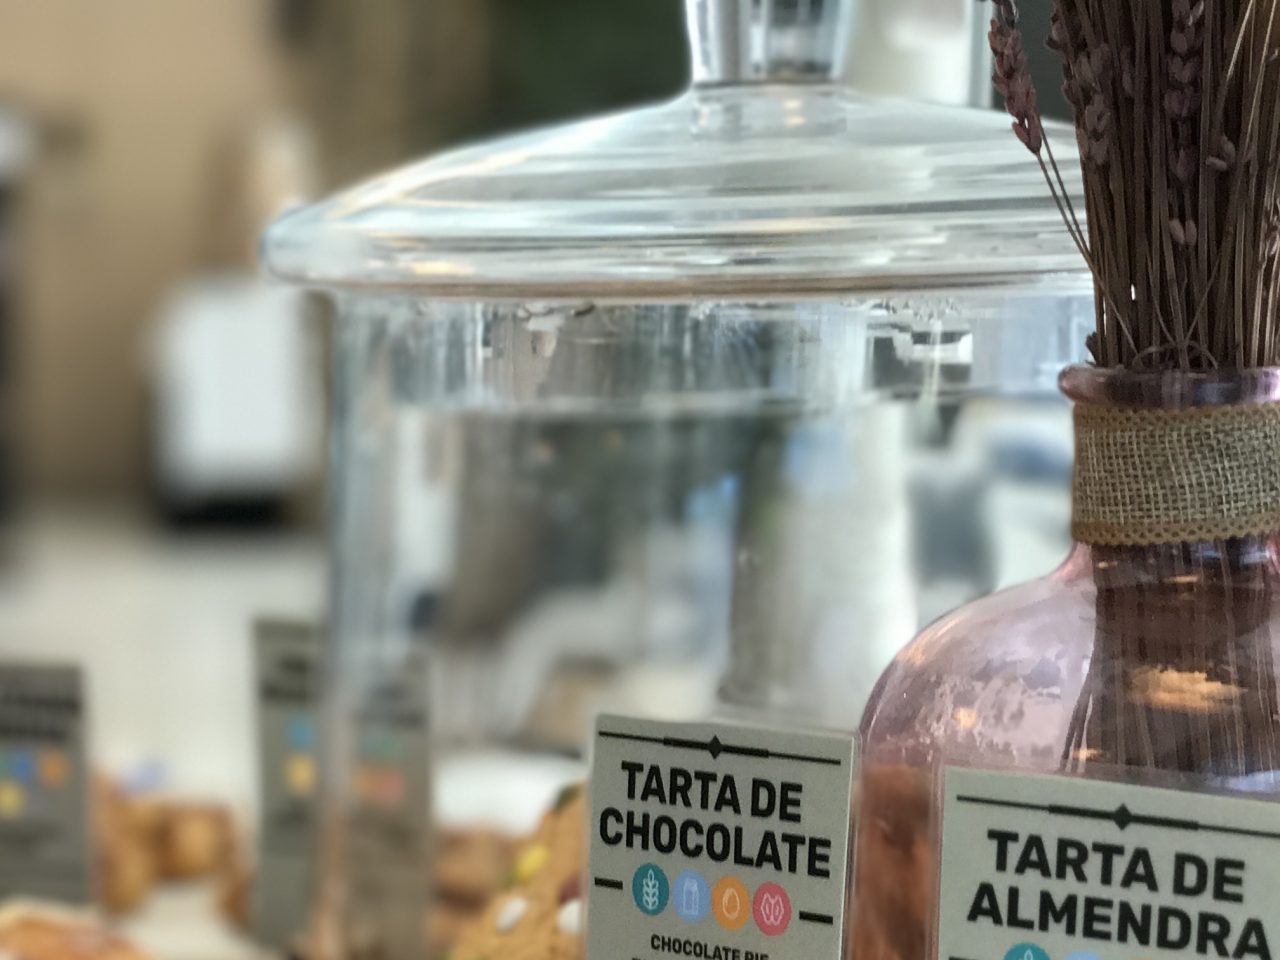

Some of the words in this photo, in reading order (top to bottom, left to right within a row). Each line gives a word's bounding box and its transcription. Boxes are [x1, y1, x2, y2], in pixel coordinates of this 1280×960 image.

[621, 760, 741, 814] TARTA
[751, 778, 803, 823] DE
[599, 807, 831, 879] CHOCOLATE
[987, 829, 1159, 893] TARTA
[1173, 851, 1245, 903] DE
